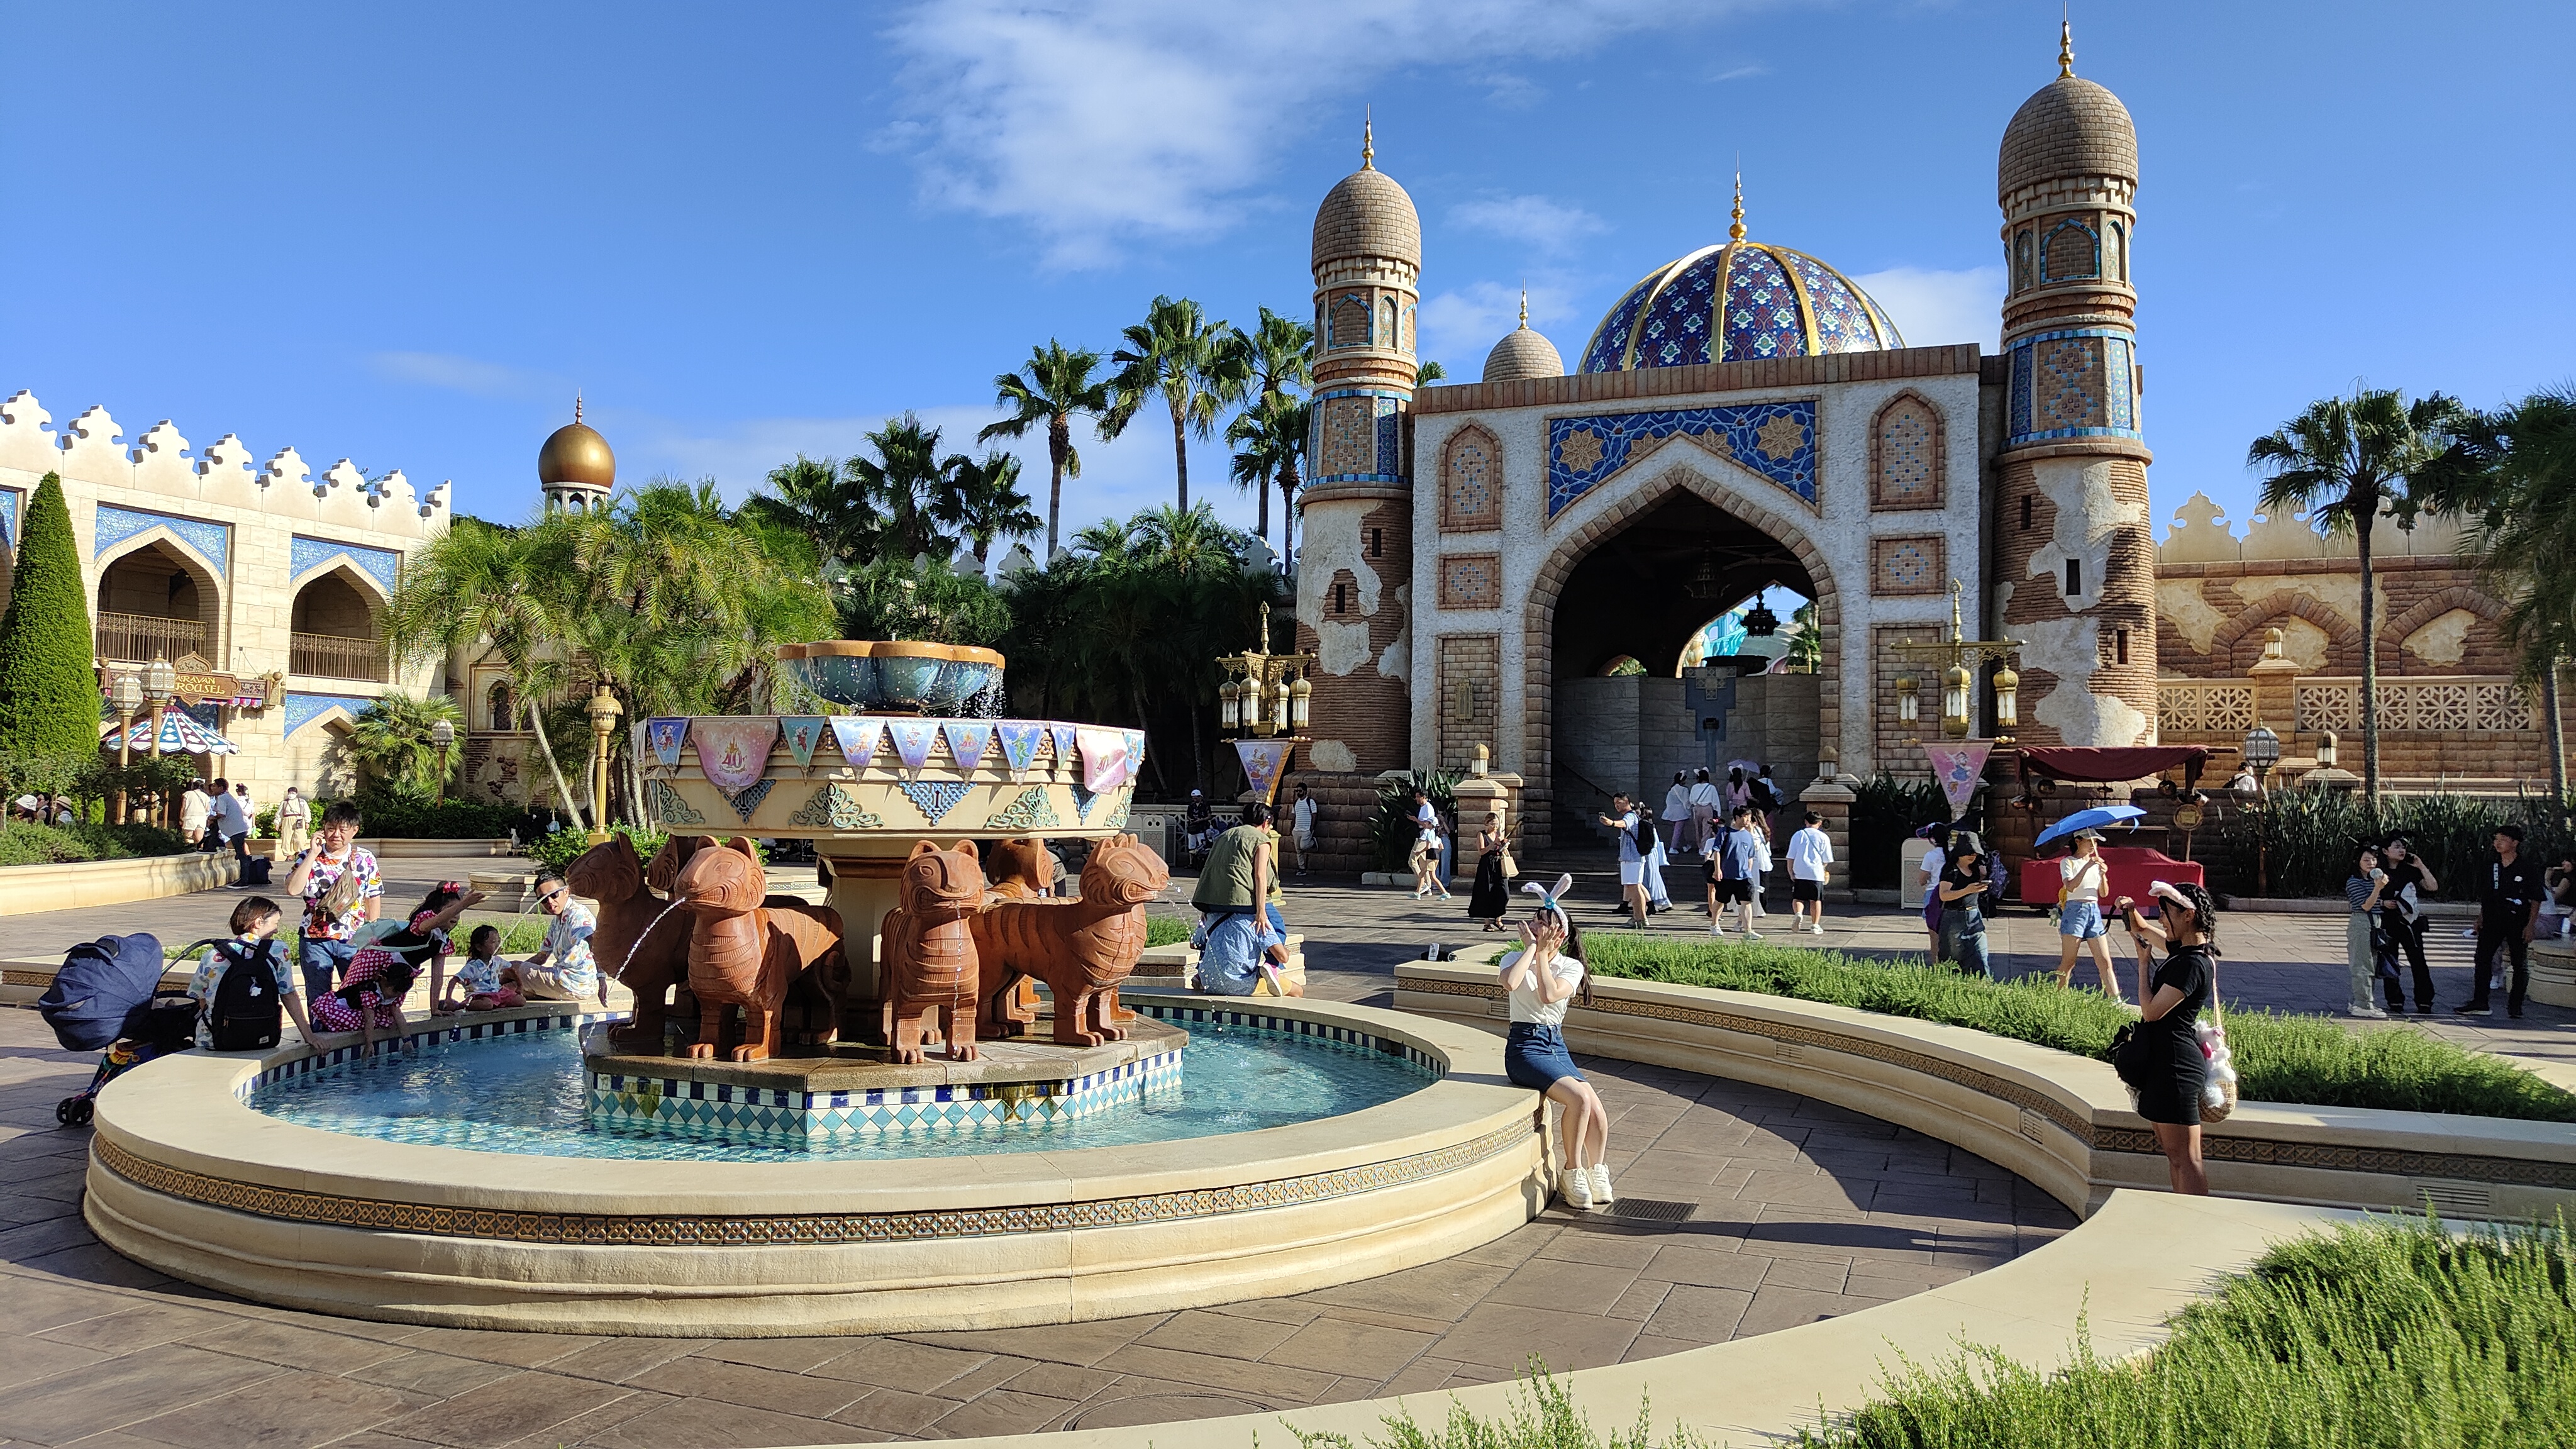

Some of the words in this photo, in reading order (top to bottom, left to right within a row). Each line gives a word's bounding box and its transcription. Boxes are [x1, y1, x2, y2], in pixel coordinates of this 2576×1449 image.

[175, 675, 216, 684] ARAVAN
[175, 682, 225, 694] ROUSEL
[721, 748, 743, 769] 40
